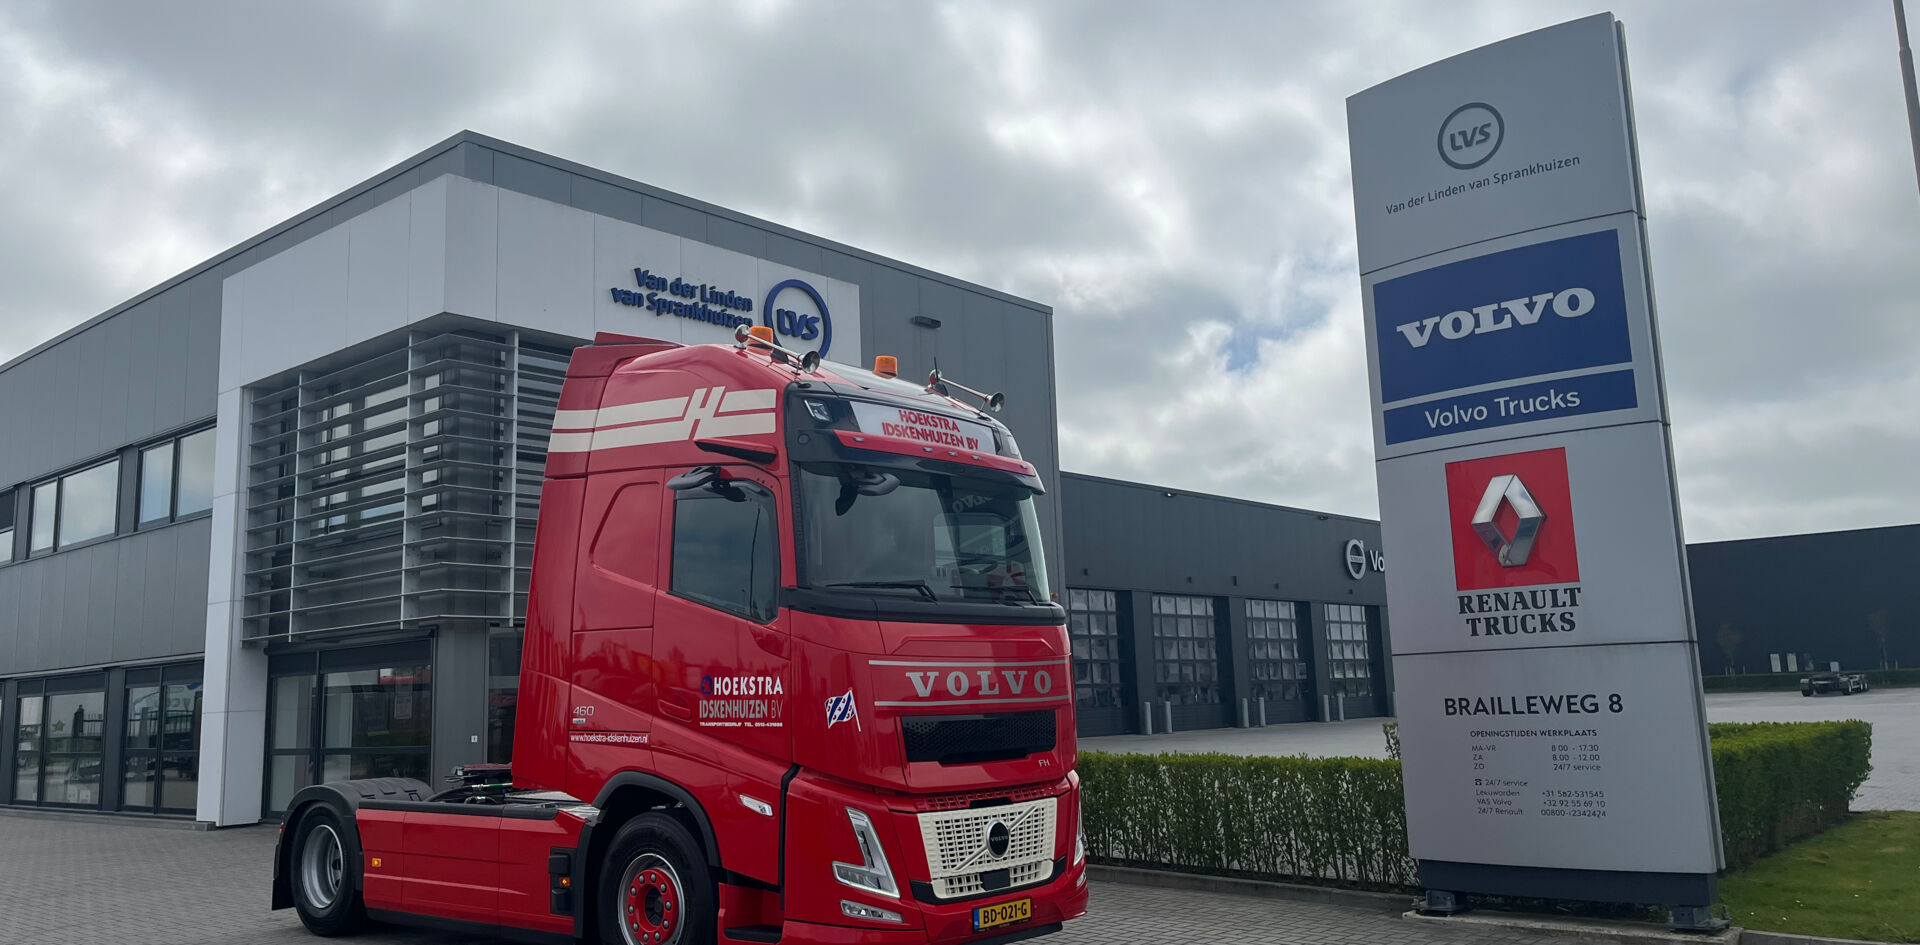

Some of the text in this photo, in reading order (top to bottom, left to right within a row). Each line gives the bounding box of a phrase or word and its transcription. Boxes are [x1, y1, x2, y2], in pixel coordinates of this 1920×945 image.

[1449, 122, 1492, 151] LVS
[1386, 155, 1581, 215] Van der Linden van Sprankhuizen
[634, 267, 753, 312] Van der Linden
[610, 287, 753, 329] van Sprankhuizen
[1396, 287, 1596, 349] VOLVO
[776, 308, 820, 341] LVS
[1425, 388, 1581, 429] Volvo Trucks
[898, 409, 961, 433] HOEKSTRA
[881, 422, 979, 450] IDSKENHUIZEN BV
[1458, 587, 1582, 614] RENAULT
[1466, 611, 1576, 637] TRUCKS
[714, 676, 784, 696] HOEKSTRA
[905, 669, 1052, 698] VOLVO
[572, 705, 595, 716] 460
[699, 699, 784, 719] IDSKENHUIZEN BV
[1444, 693, 1624, 716] BRAILLEWEG 8
[570, 733, 649, 743] www.hoekstra-idskenhuizen.nl
[1470, 729, 1598, 738] OPENINGSTIJDEN WERKPLAATS
[1471, 744, 1497, 752] MA-VR
[1472, 753, 1484, 761] ZA
[1038, 759, 1051, 768] FH
[1473, 762, 1485, 770] ZO
[1553, 763, 1602, 771] 24/7 service
[1477, 807, 1523, 816] 24/7 Renault
[1492, 798, 1513, 806] Volvo
[1559, 799, 1569, 807] 92
[1571, 800, 1582, 808] 55
[1583, 800, 1593, 808] 69
[1596, 800, 1606, 808] 10
[983, 902, 1028, 924] BD-021-G
